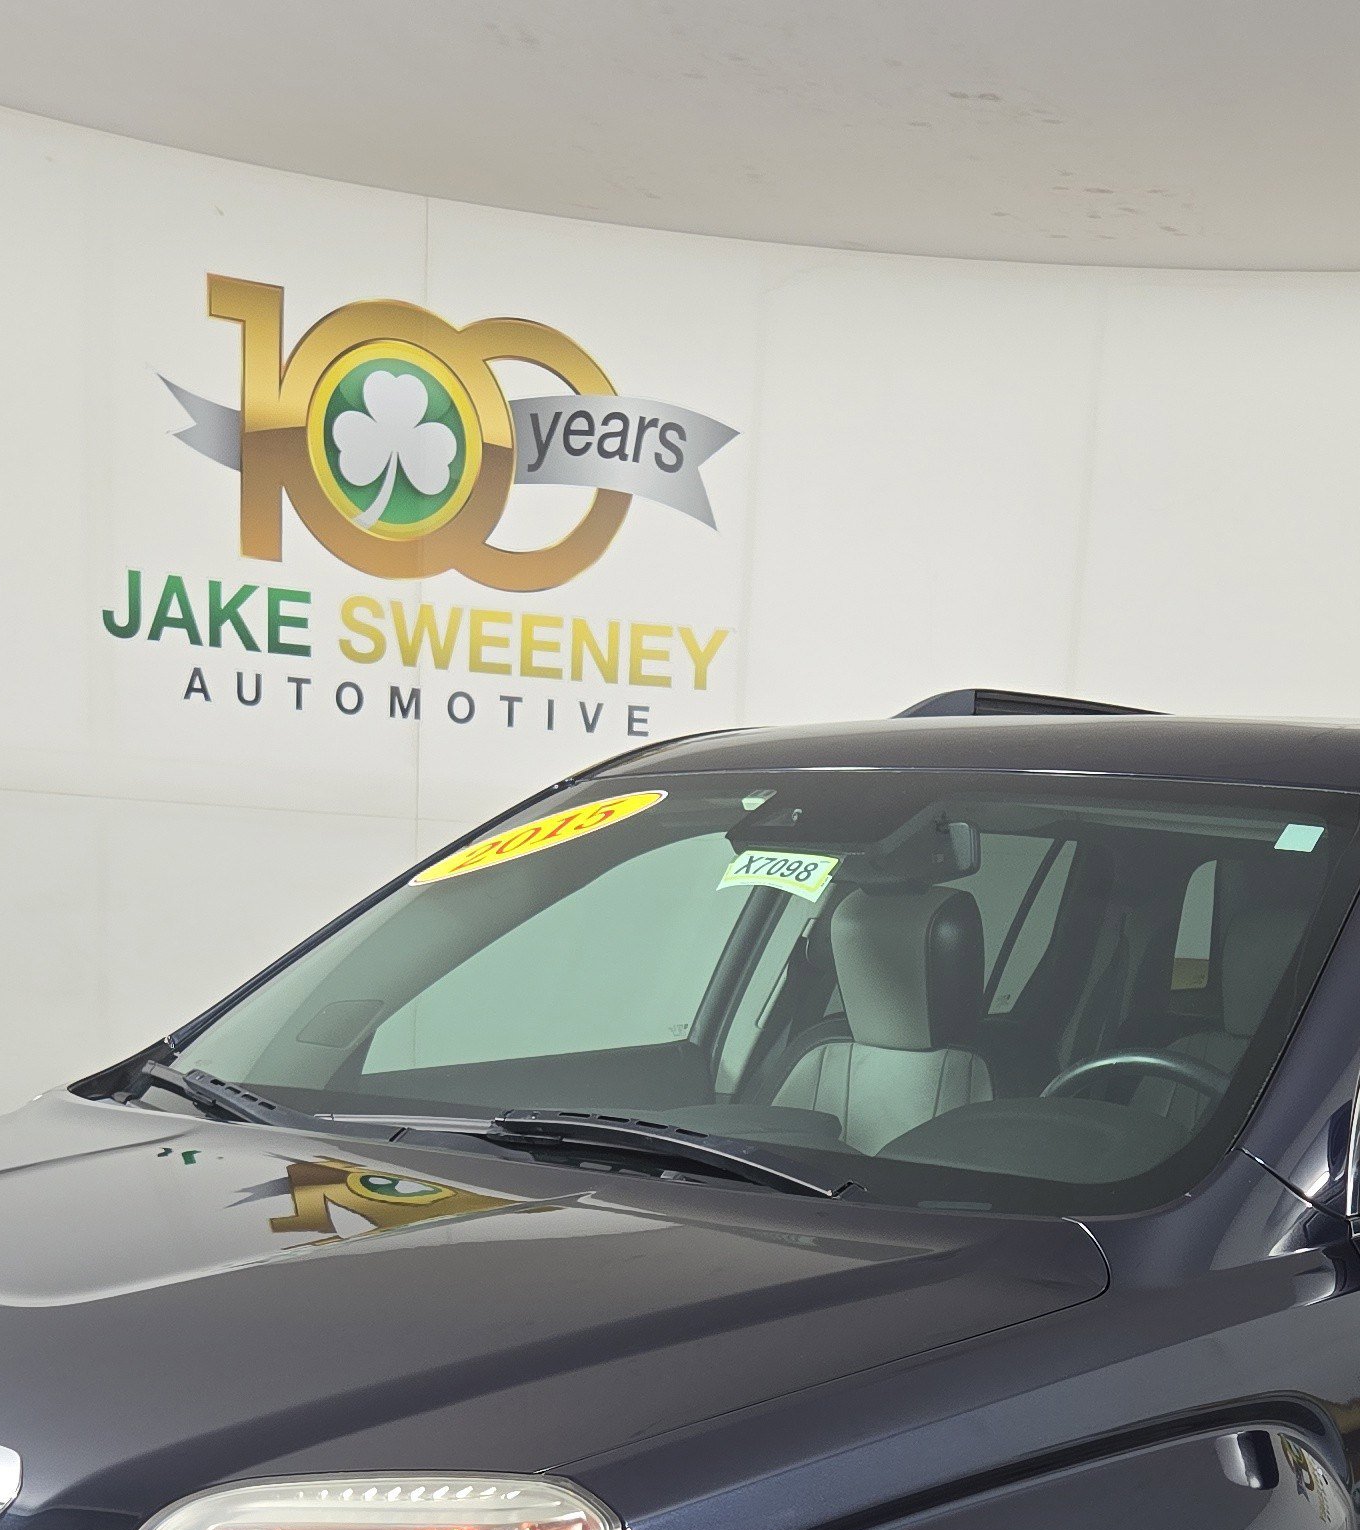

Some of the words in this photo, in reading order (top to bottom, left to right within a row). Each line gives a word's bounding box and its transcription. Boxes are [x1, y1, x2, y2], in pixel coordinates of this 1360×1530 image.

[207, 272, 635, 592] 100
[527, 405, 688, 473] years
[102, 569, 312, 658] JAKE
[339, 595, 735, 690] SWEENEY
[184, 667, 650, 738] AUTOMOTIVE
[449, 800, 627, 873] 2015
[734, 855, 819, 883] X7098
